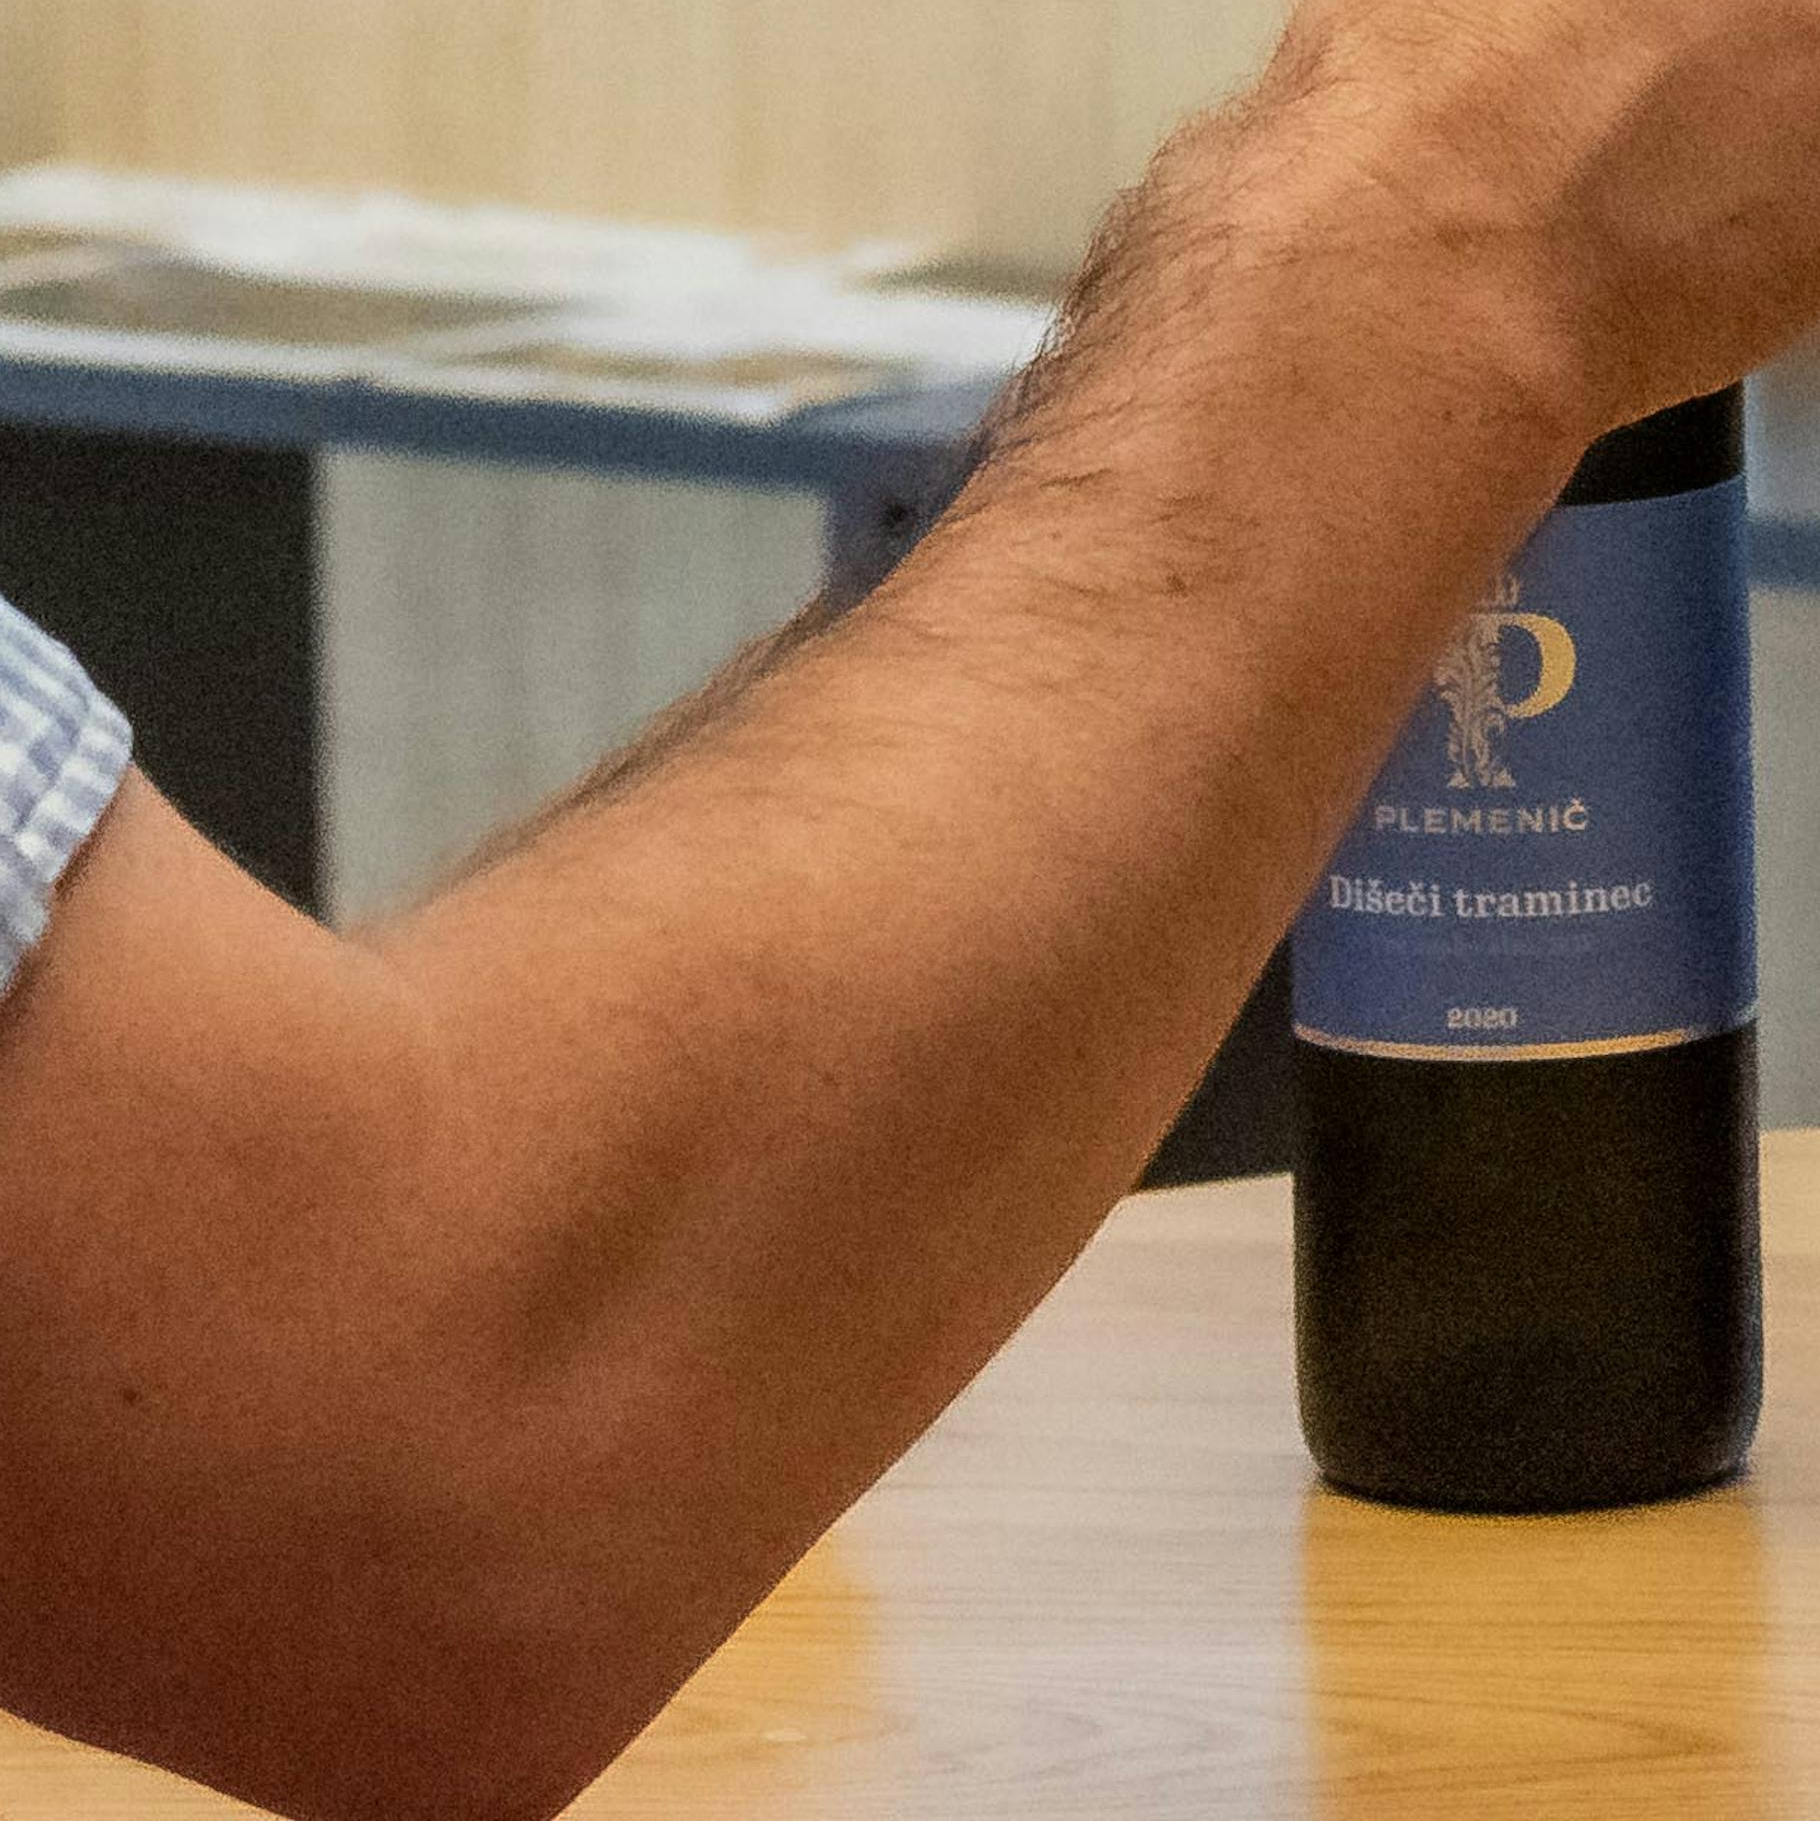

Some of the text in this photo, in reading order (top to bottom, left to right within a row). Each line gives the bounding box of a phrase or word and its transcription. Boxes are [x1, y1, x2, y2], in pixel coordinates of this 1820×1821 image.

[1374, 797, 1588, 834] PLEMENIČ
[1329, 874, 1653, 918] Dišeči traminec
[1447, 1007, 1519, 1030] 2020
